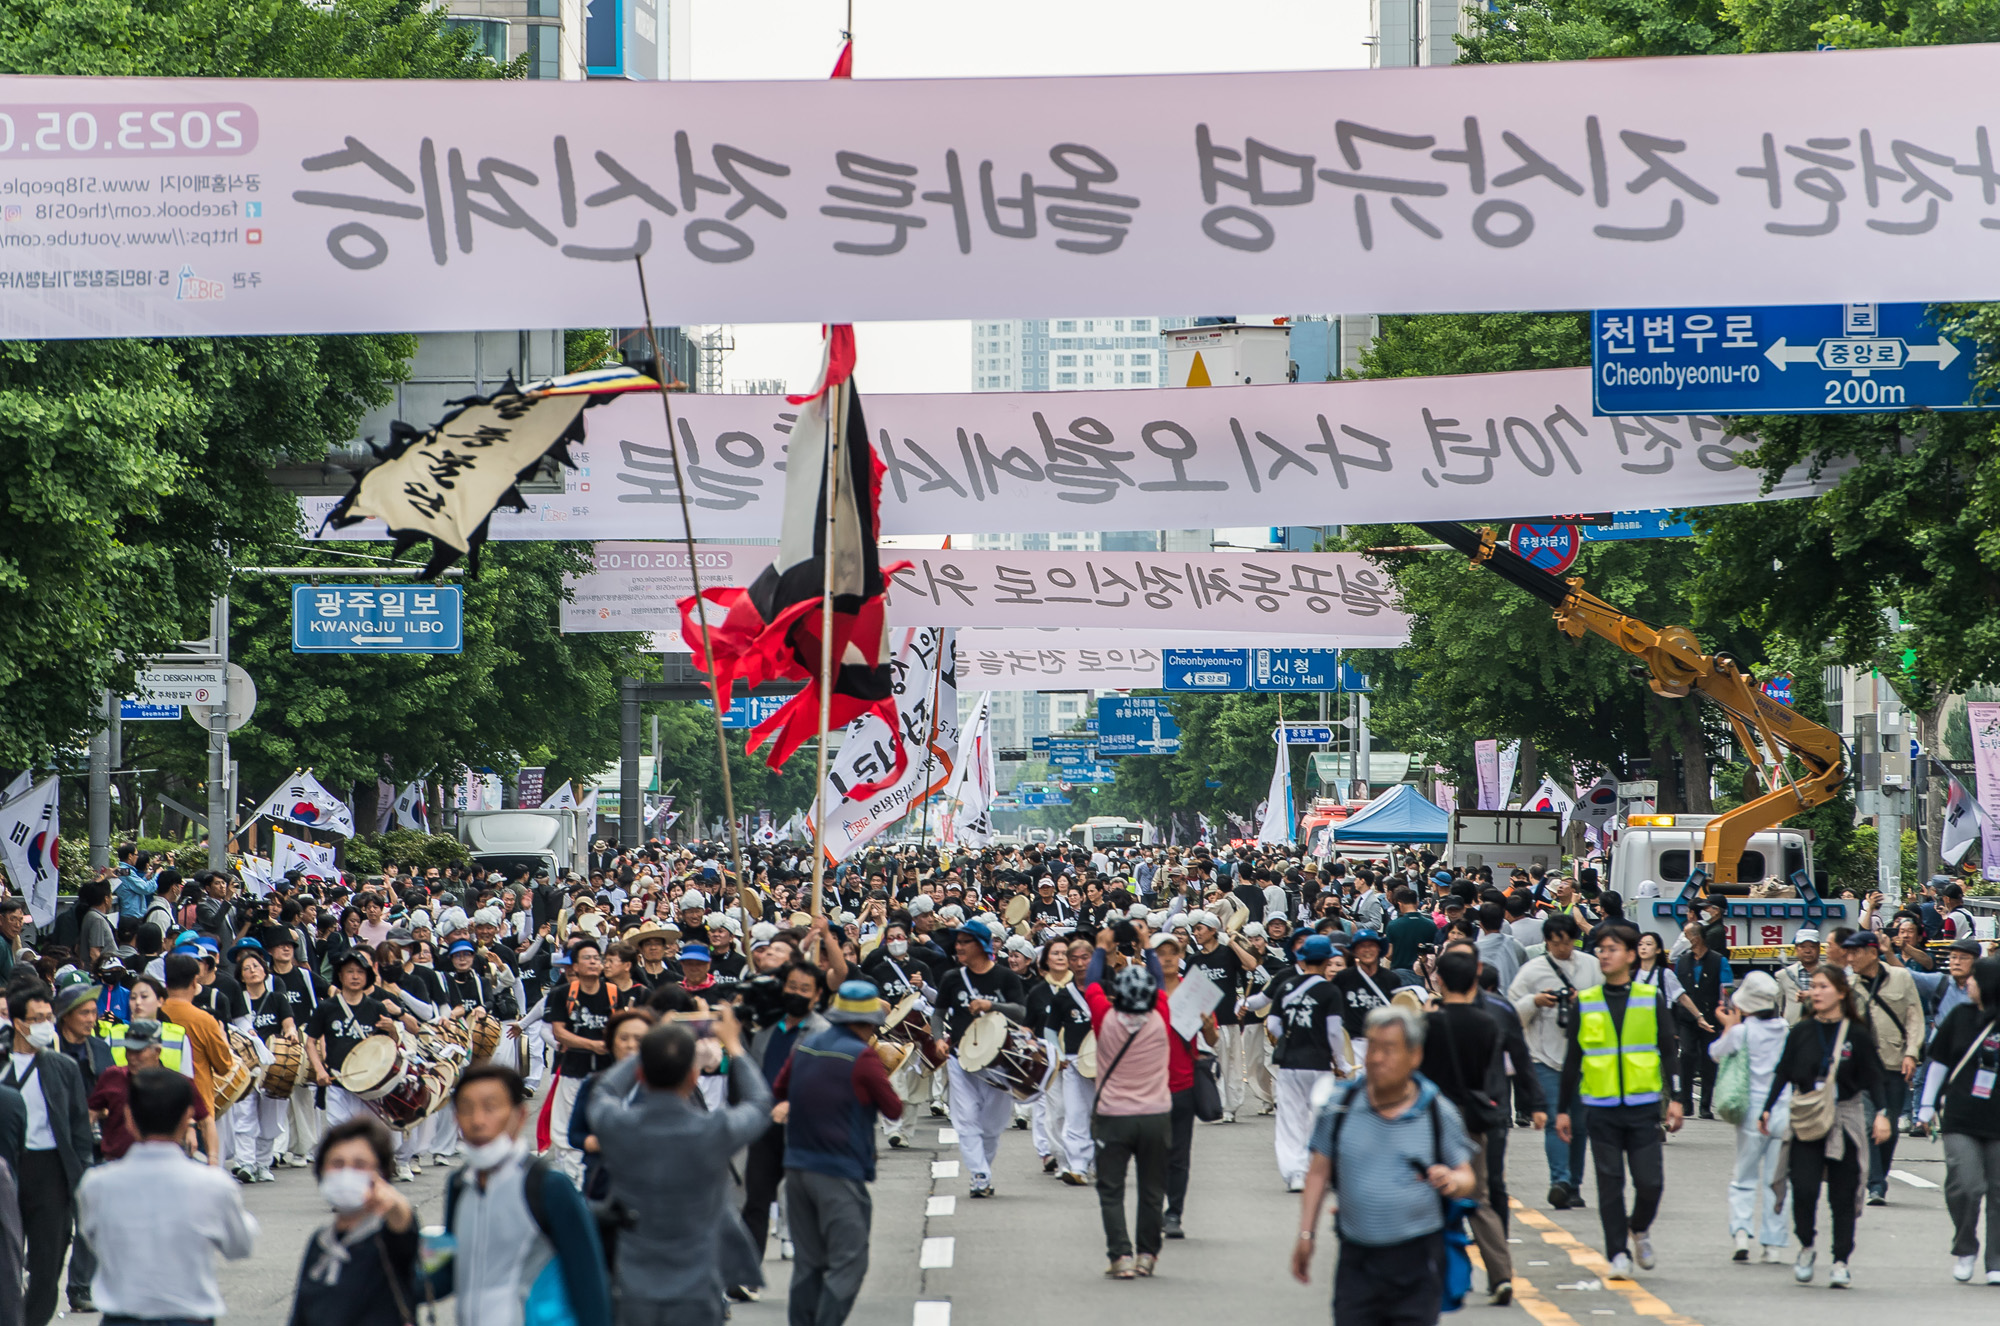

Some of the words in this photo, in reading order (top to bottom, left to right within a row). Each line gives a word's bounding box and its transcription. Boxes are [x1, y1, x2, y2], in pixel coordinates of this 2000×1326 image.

[1600, 313, 1759, 355] 천변우로
[1829, 344, 1897, 365] 중앙로
[1601, 361, 1760, 391] Cheonbyeonu-ro
[1824, 380, 1906, 405] 200m
[1519, 535, 1569, 549] 주정차금지
[314, 591, 440, 618] 광주일보
[310, 619, 397, 635] KWANGJU
[404, 619, 444, 634] ILBO
[1169, 655, 1243, 668] Cheonbyeonu-ro
[1272, 658, 1310, 674] 시청
[163, 673, 192, 683] DESIGN
[193, 674, 218, 683] HOTEL
[1271, 674, 1296, 687] City
[1301, 674, 1324, 686] Hall
[1292, 728, 1314, 737] 중앙로
